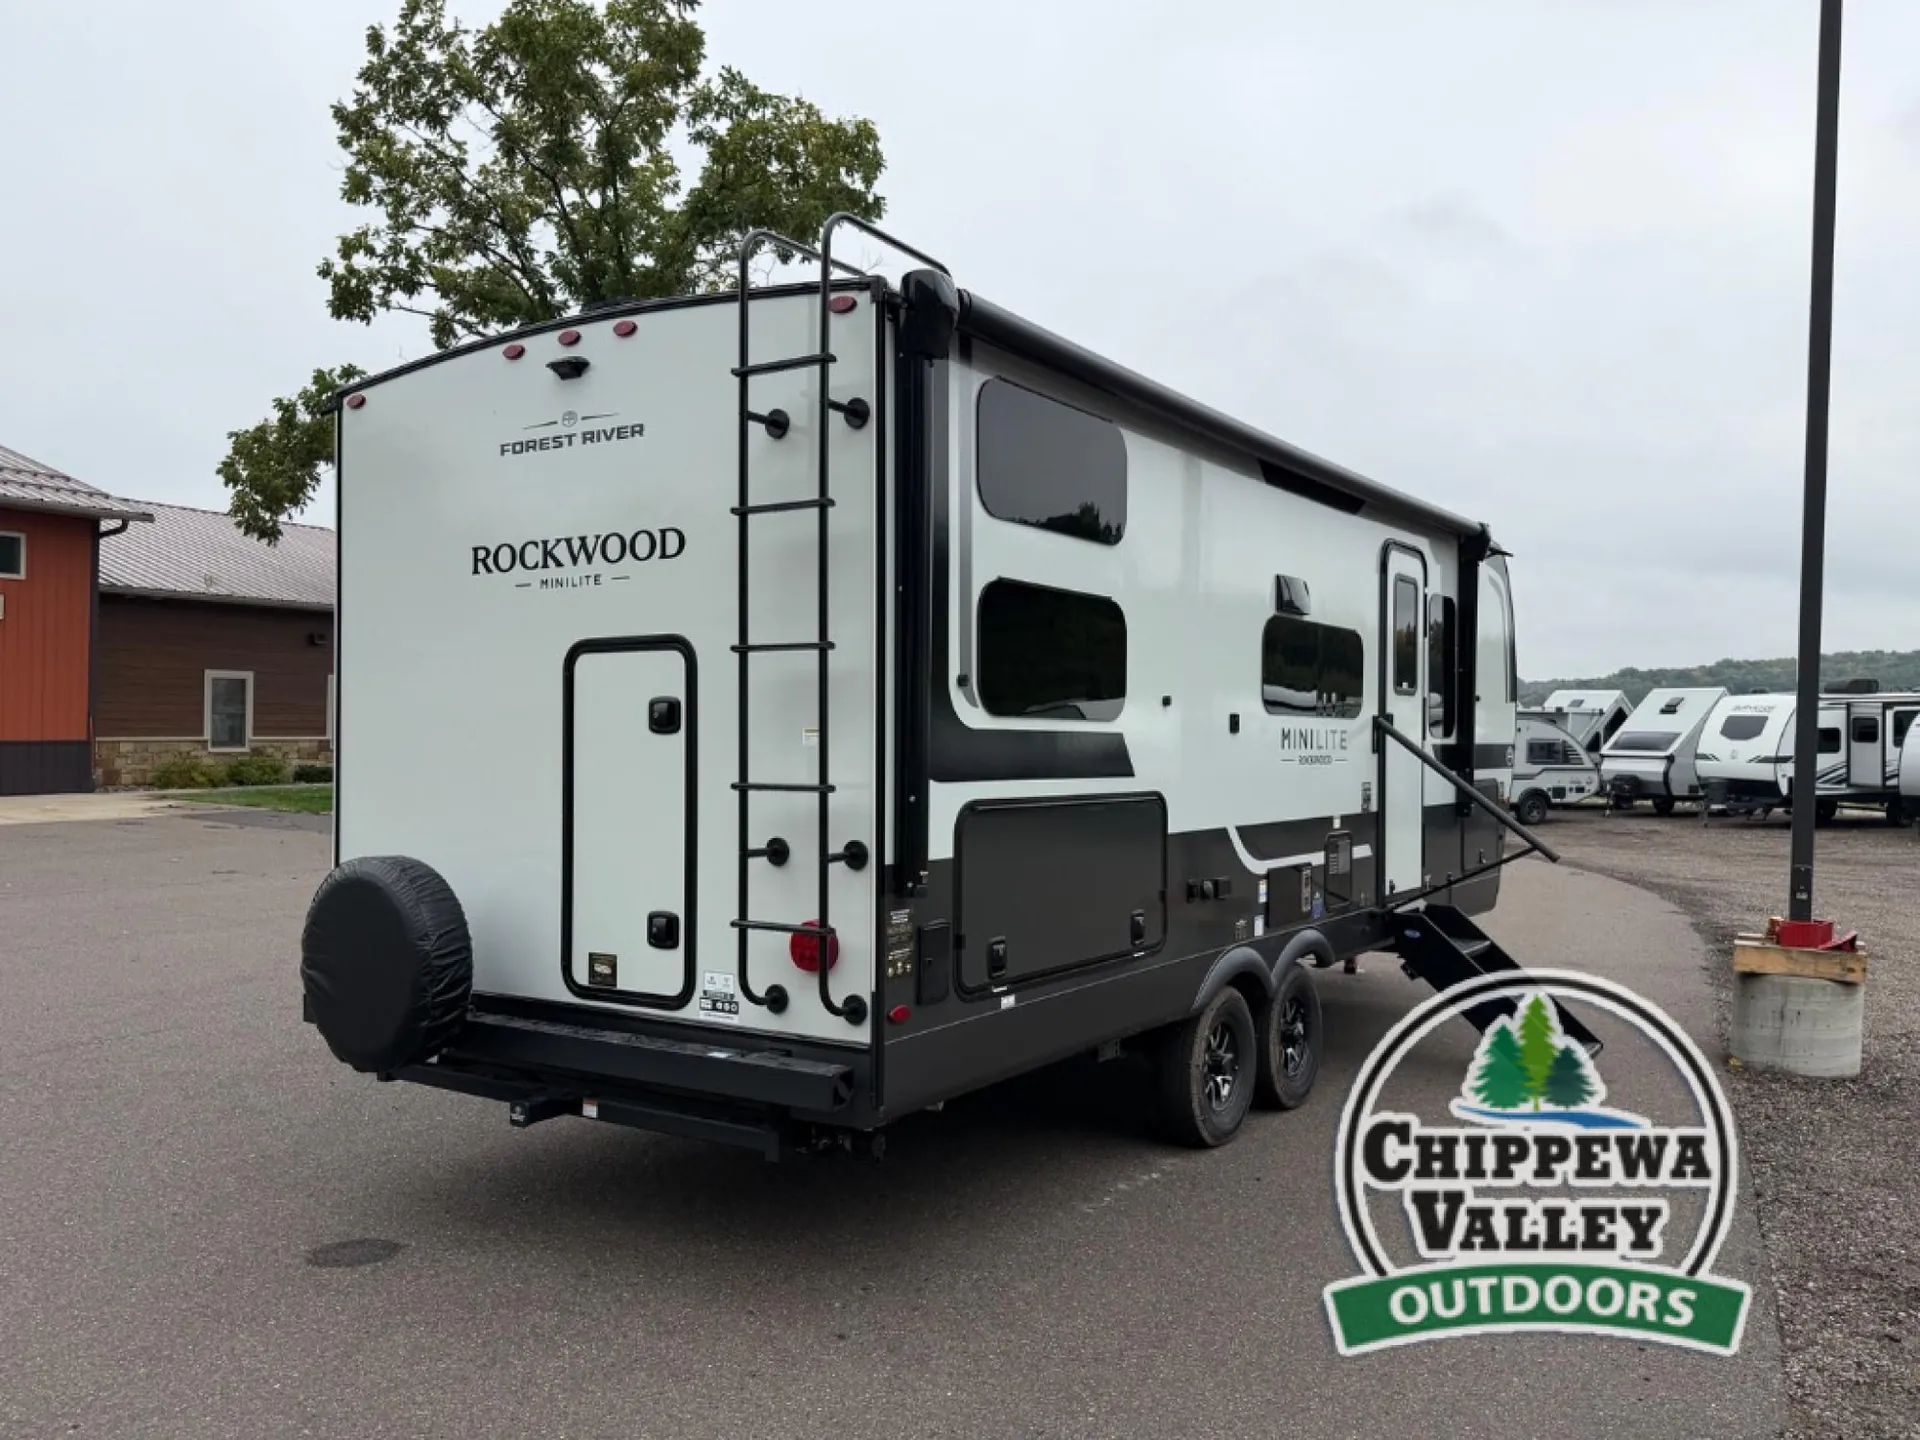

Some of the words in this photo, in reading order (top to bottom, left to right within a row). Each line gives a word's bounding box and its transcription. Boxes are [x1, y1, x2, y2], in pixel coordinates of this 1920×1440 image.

[500, 433, 577, 456] FOREST
[581, 423, 645, 445] RIVER
[471, 527, 686, 575] ROCKWOOD
[540, 574, 602, 589] MINILITE
[1281, 727, 1348, 750] MINILITE
